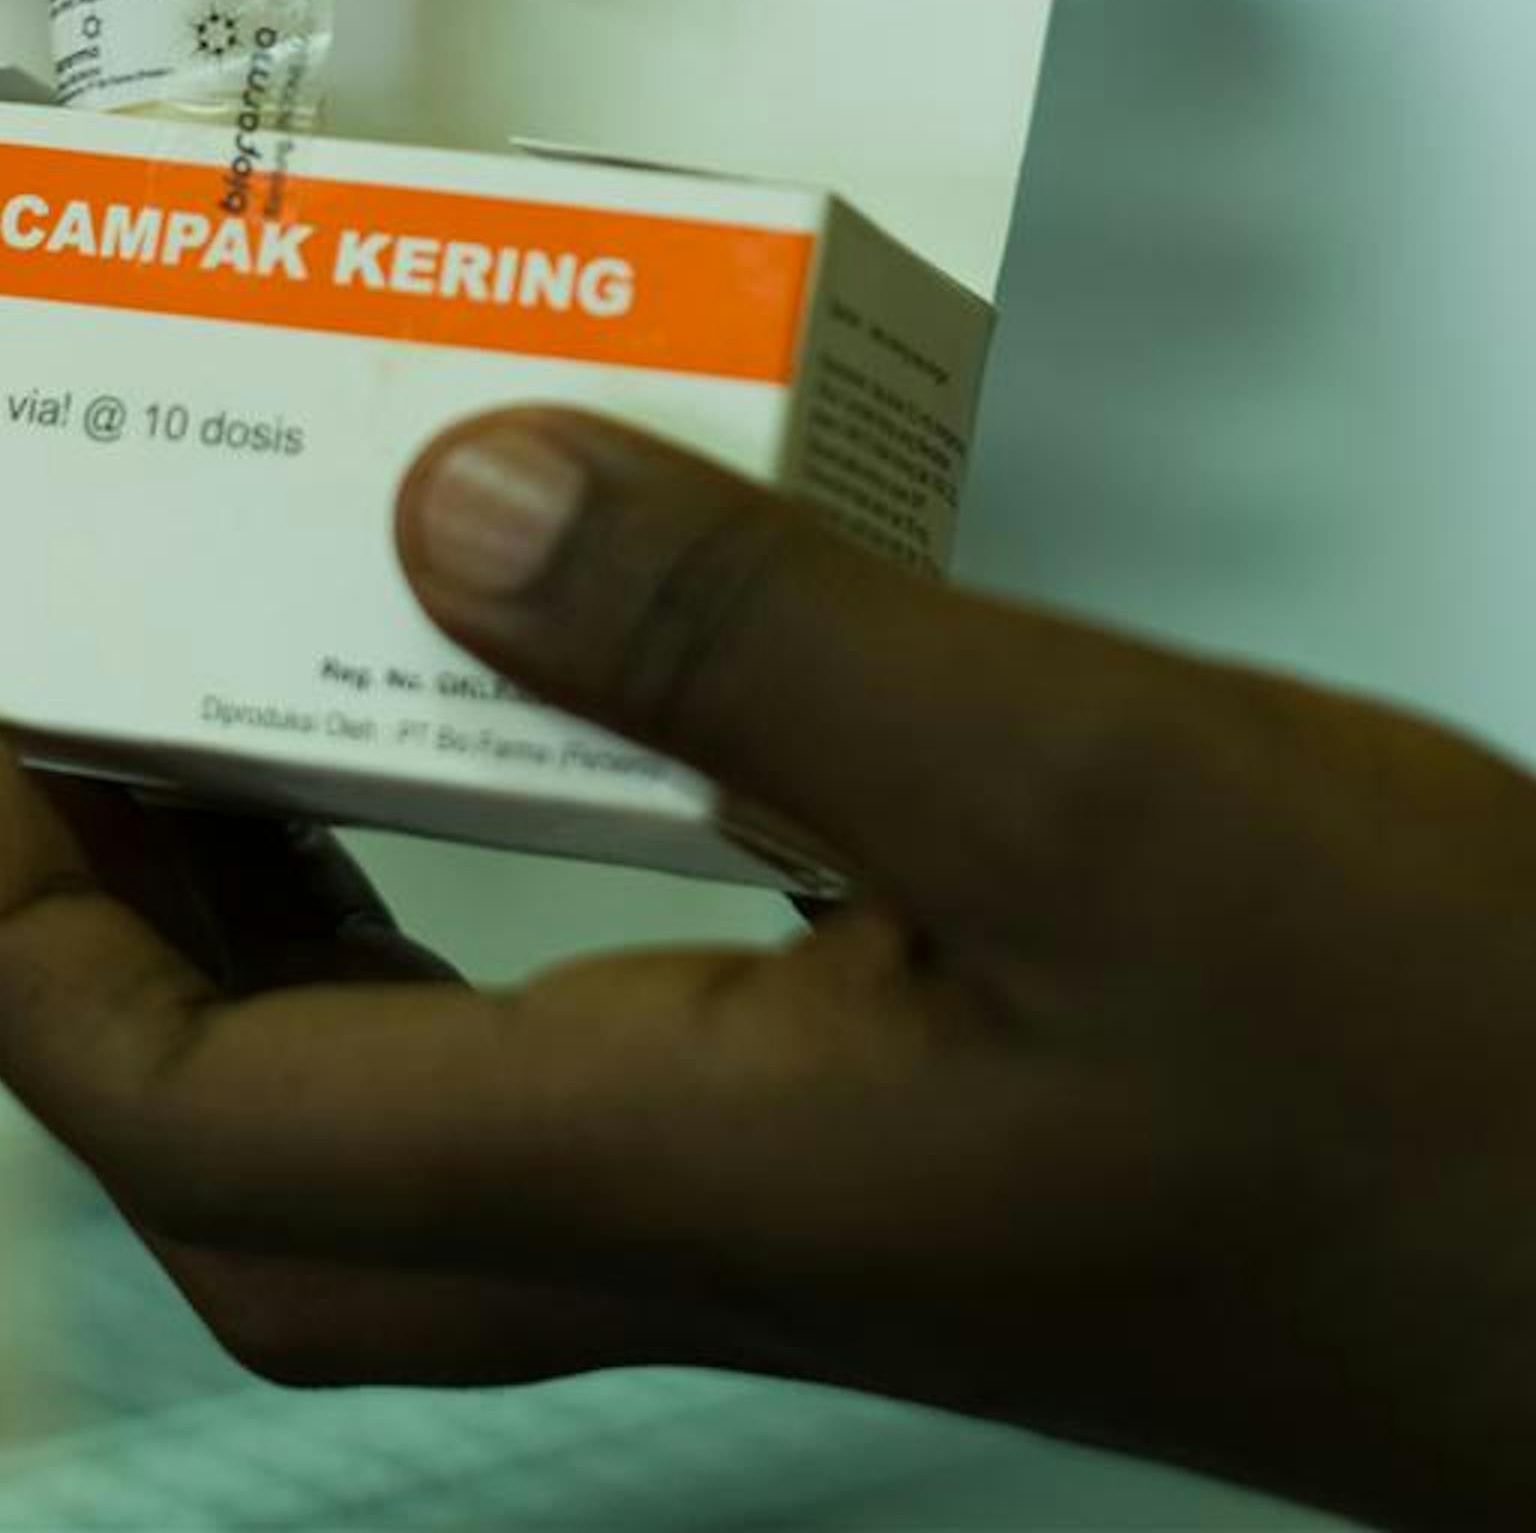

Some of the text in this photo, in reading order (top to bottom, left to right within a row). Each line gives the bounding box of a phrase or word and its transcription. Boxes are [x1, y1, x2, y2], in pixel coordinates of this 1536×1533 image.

[0, 193, 315, 280] CAMPAK
[332, 228, 637, 318] KERING
[83, 394, 127, 444] @
[143, 403, 190, 442] 10
[199, 410, 305, 457] dosis
